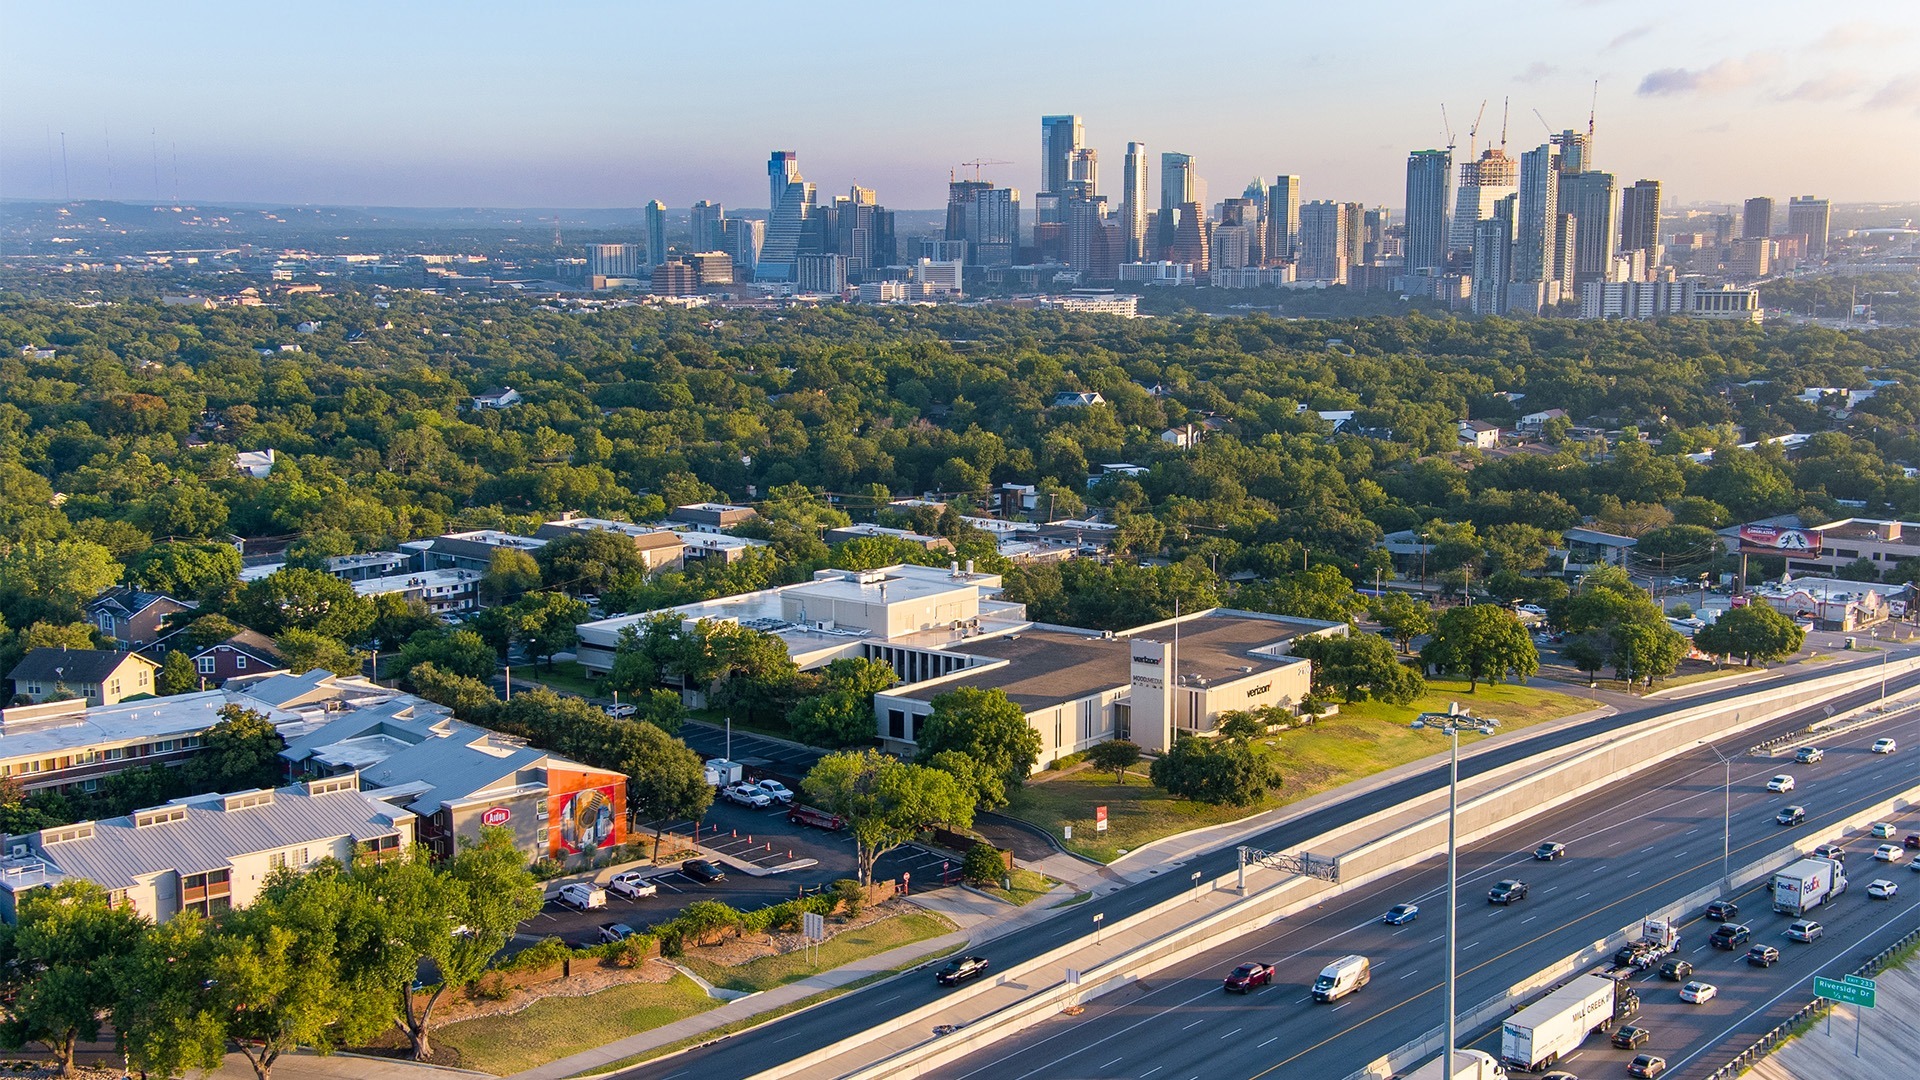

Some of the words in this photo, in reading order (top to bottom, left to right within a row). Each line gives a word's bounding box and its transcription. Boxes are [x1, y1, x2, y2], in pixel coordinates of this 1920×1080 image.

[1133, 656, 1160, 665] verizon
[1247, 684, 1270, 698] verizon
[1777, 881, 1798, 892] FedEx
[1803, 876, 1820, 895] FedEx
[1819, 980, 1857, 994] Riverside
[1572, 1009, 1586, 1022] MILL
[1587, 997, 1605, 1013] CREEK
